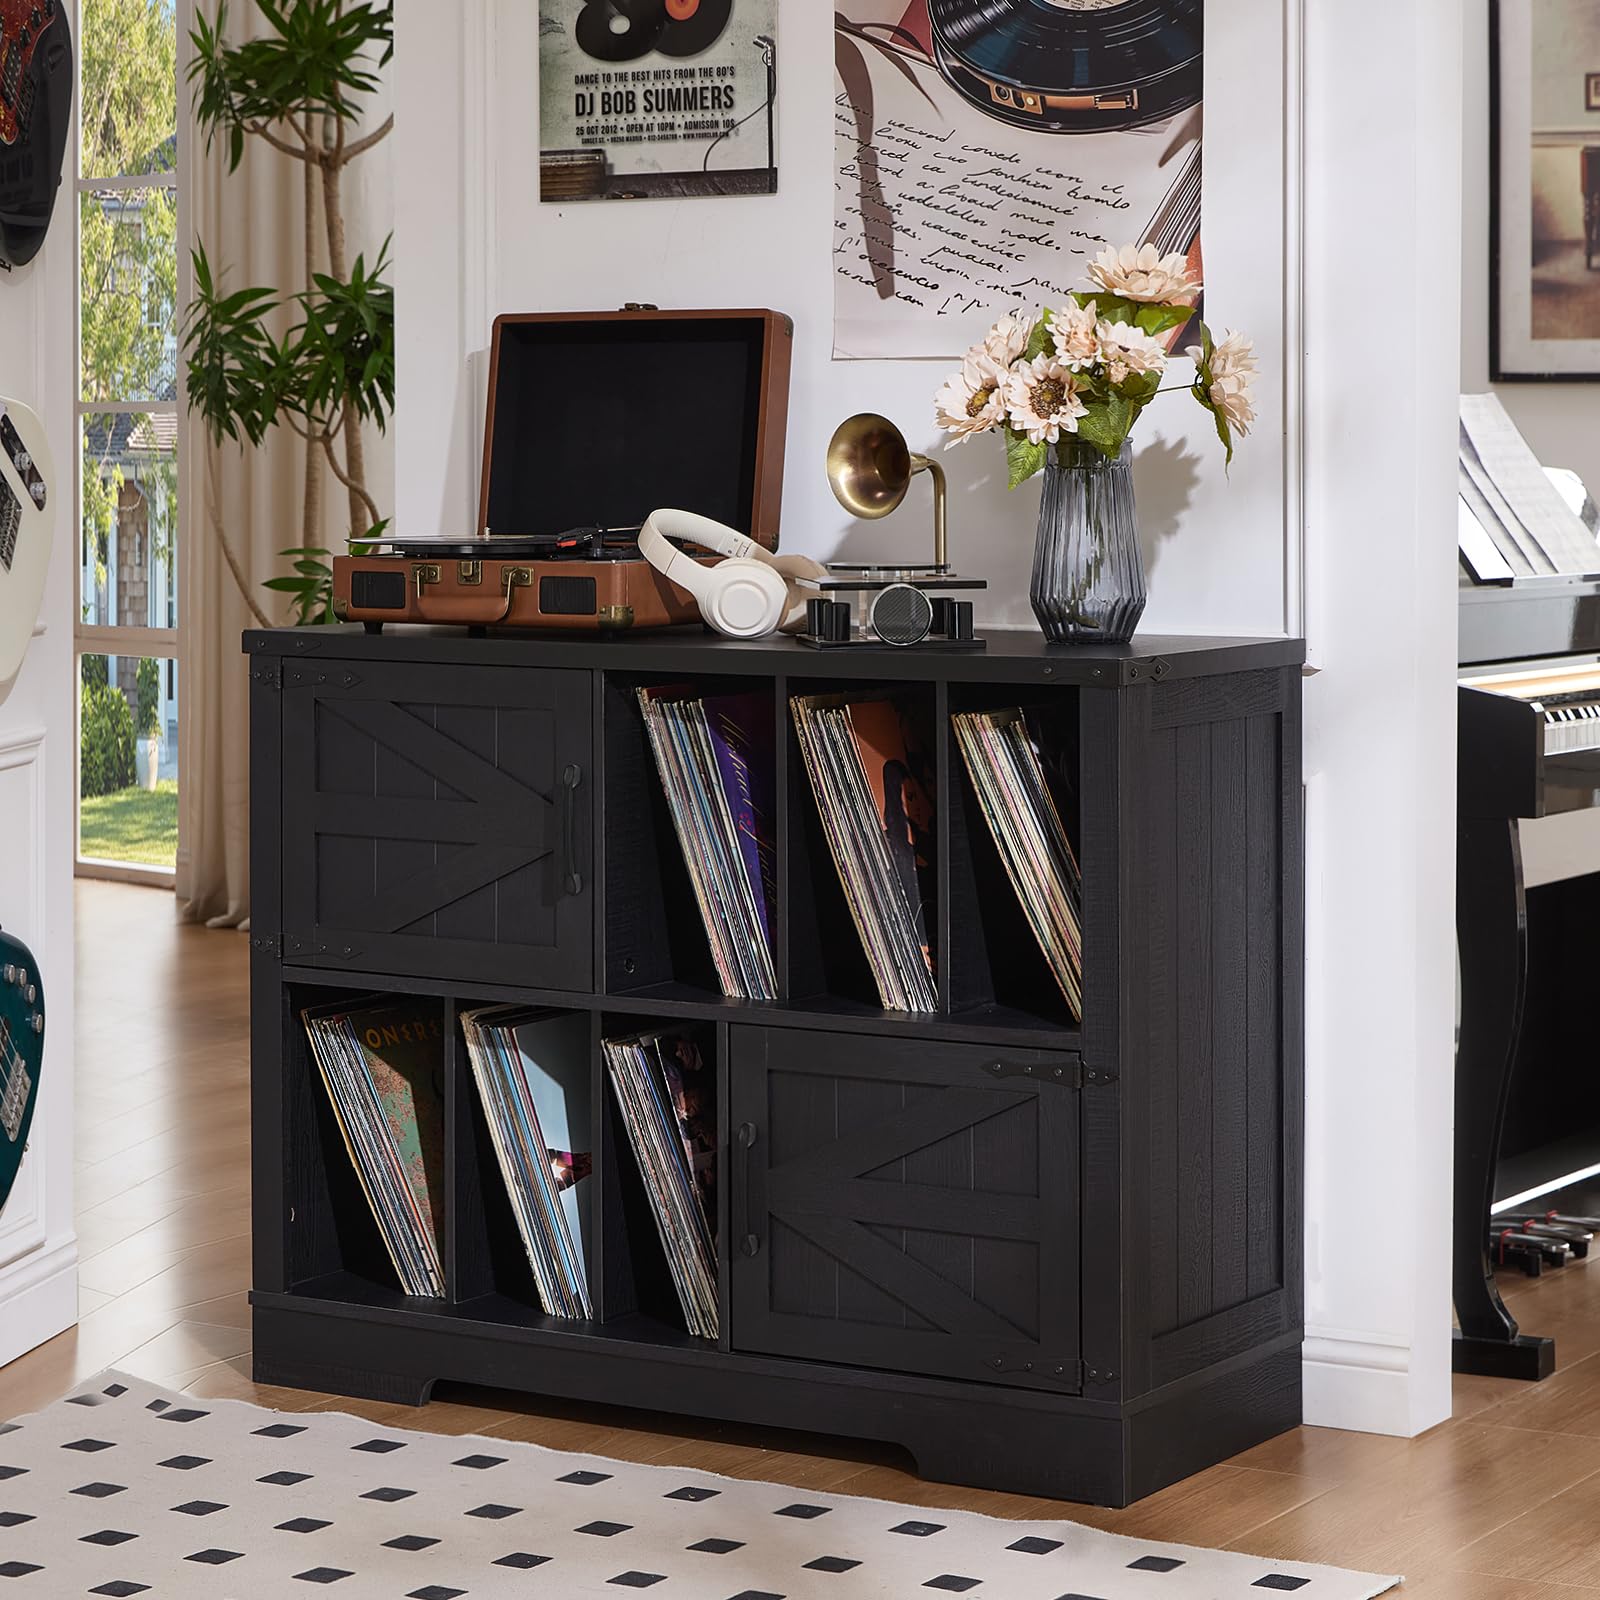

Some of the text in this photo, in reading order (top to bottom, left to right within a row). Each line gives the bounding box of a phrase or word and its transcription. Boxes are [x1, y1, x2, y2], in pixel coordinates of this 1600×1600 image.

[574, 66, 735, 85] DANCE TO THE BEST HITS FROM THE 80'S
[575, 85, 734, 117] DJ BOB SUMMERS
[576, 126, 584, 136] 25
[586, 125, 599, 135] OCT
[601, 124, 618, 134] 2012
[626, 123, 643, 133] OPEN
[645, 122, 654, 132] AT
[657, 121, 675, 132] 10PM
